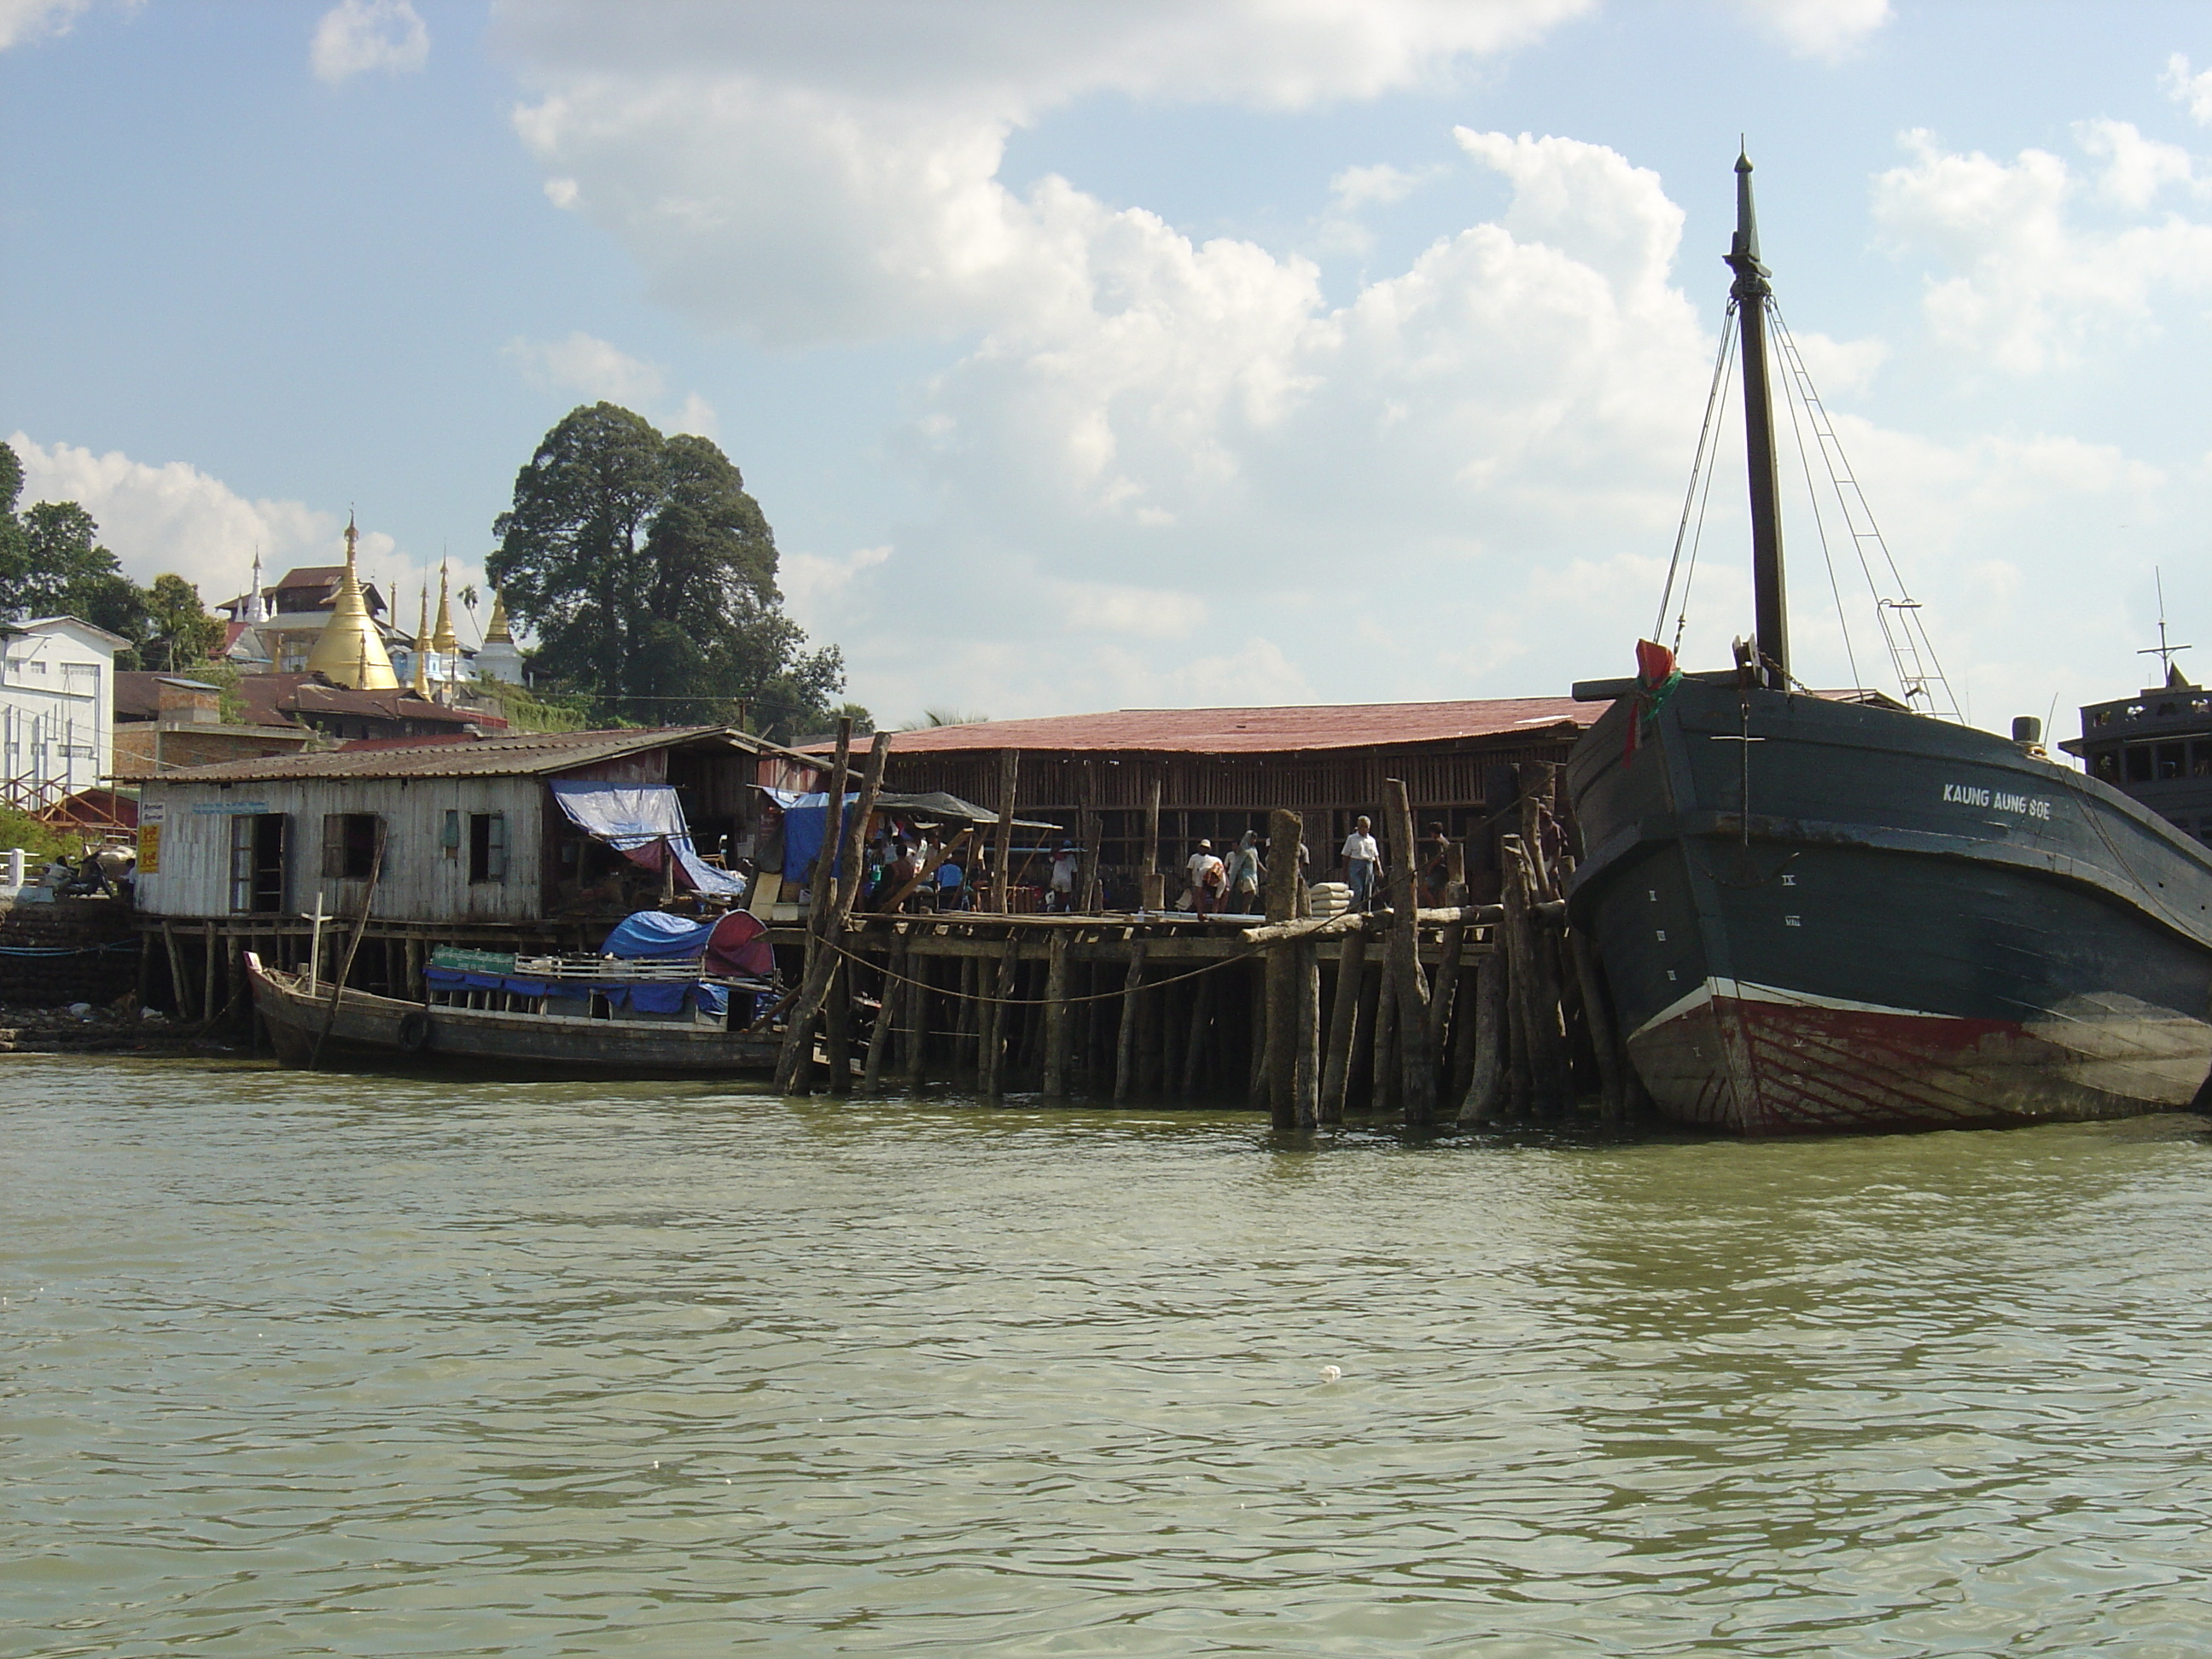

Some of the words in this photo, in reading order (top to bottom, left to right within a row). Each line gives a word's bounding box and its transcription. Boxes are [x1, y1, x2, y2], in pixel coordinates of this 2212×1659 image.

[1943, 783, 1990, 806] KAUNG
[1994, 792, 2027, 814] AUNG
[2029, 798, 2051, 820] SOE
[1782, 875, 1796, 886] IX
